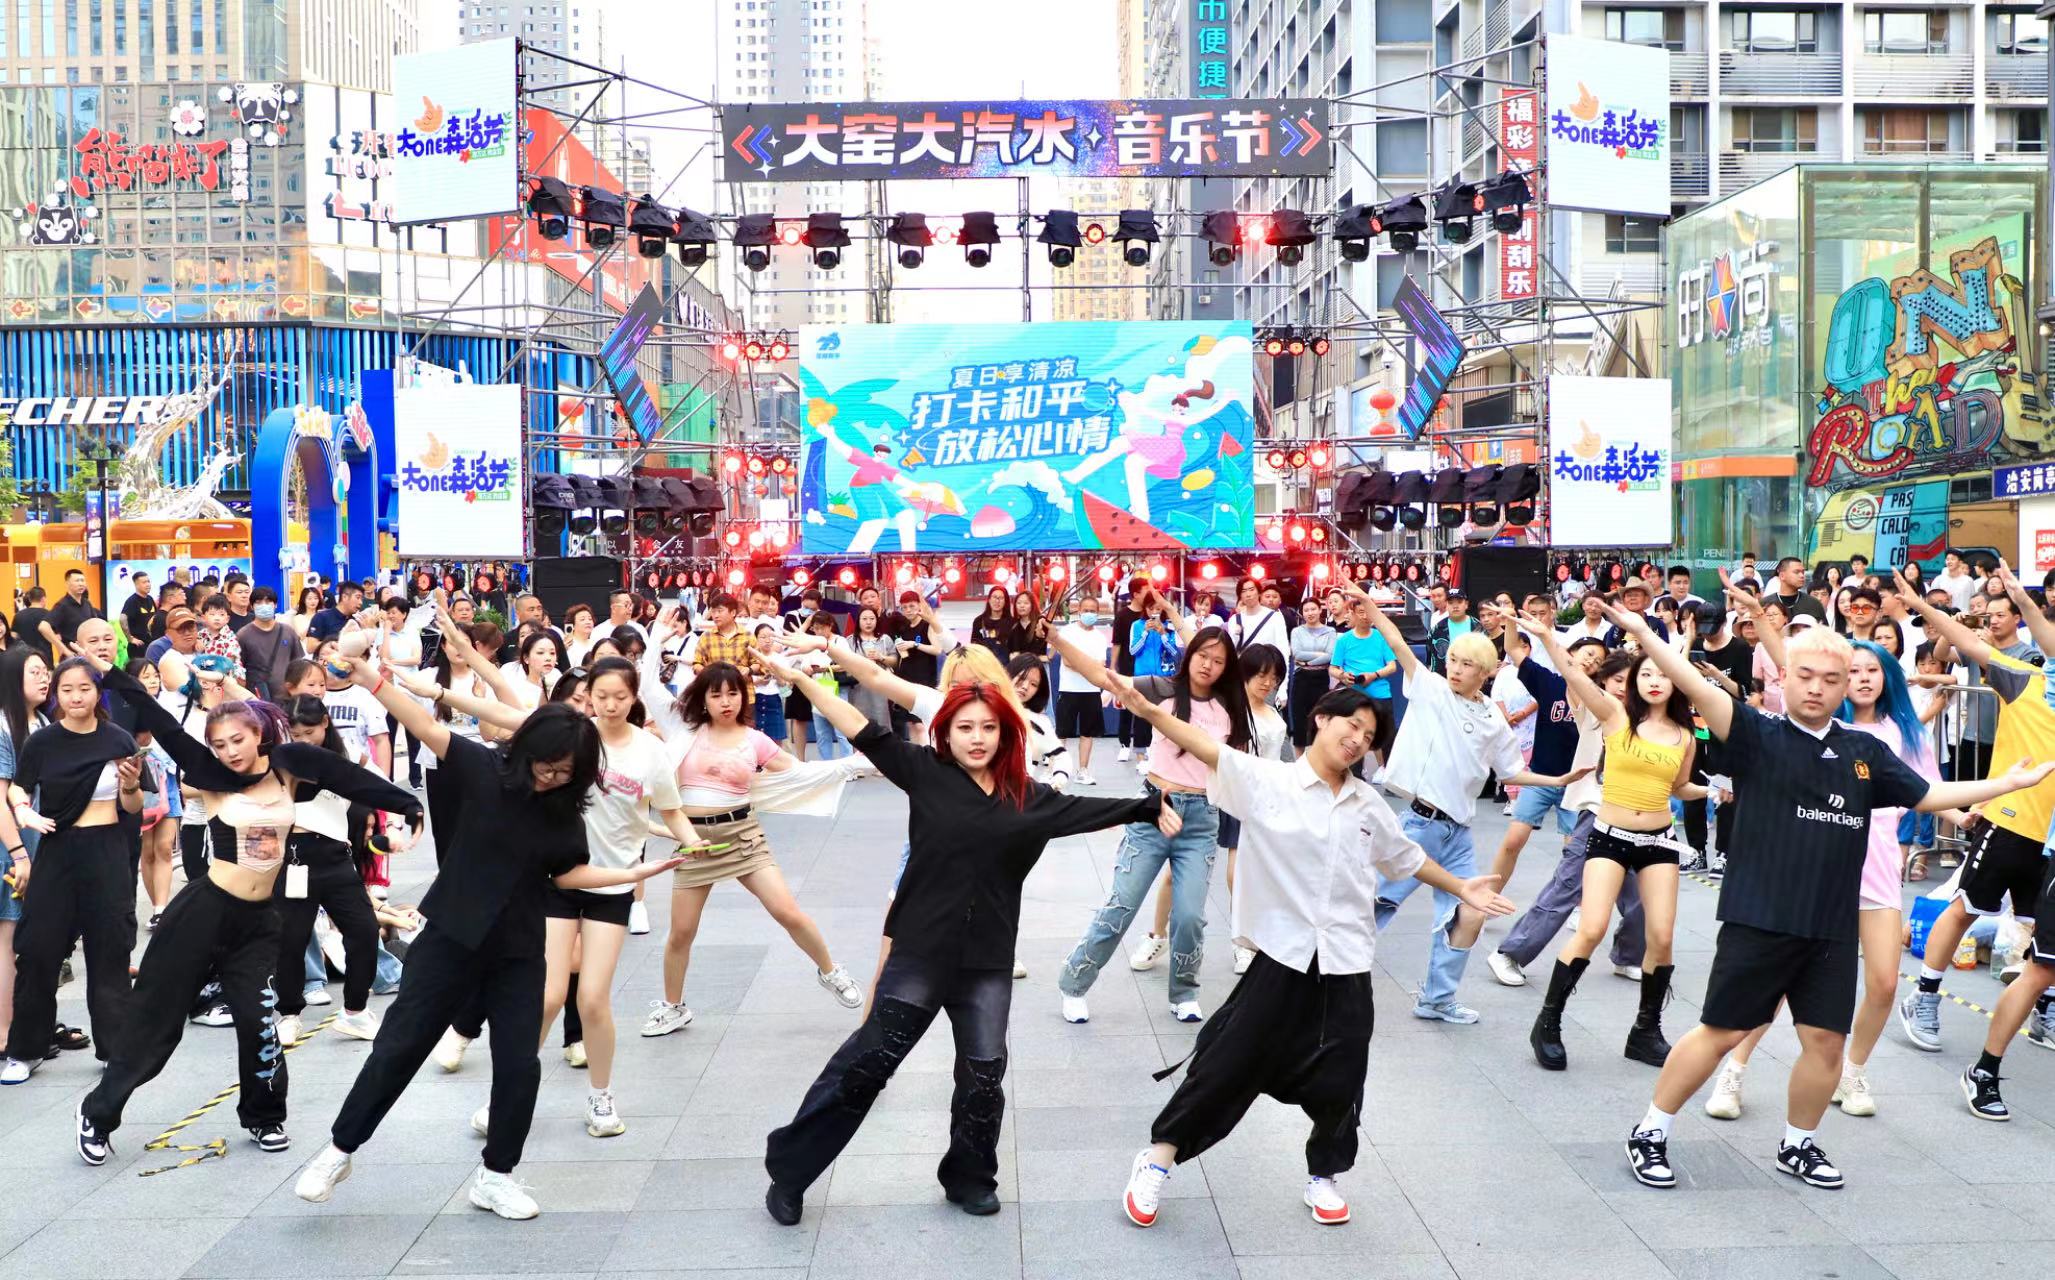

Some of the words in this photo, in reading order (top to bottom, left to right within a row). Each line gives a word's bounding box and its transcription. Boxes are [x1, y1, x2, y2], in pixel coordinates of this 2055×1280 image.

[1198, 0, 1227, 99] 市便捷
[782, 111, 1076, 165] 大窑大汽水
[1114, 110, 1271, 165] 音乐节
[1825, 236, 2009, 390] ON
[952, 358, 1076, 388] 夏日享清凉
[912, 380, 1087, 430] 打卡和平
[933, 416, 1111, 465] 放松心情
[1807, 388, 2003, 486] ROAD
